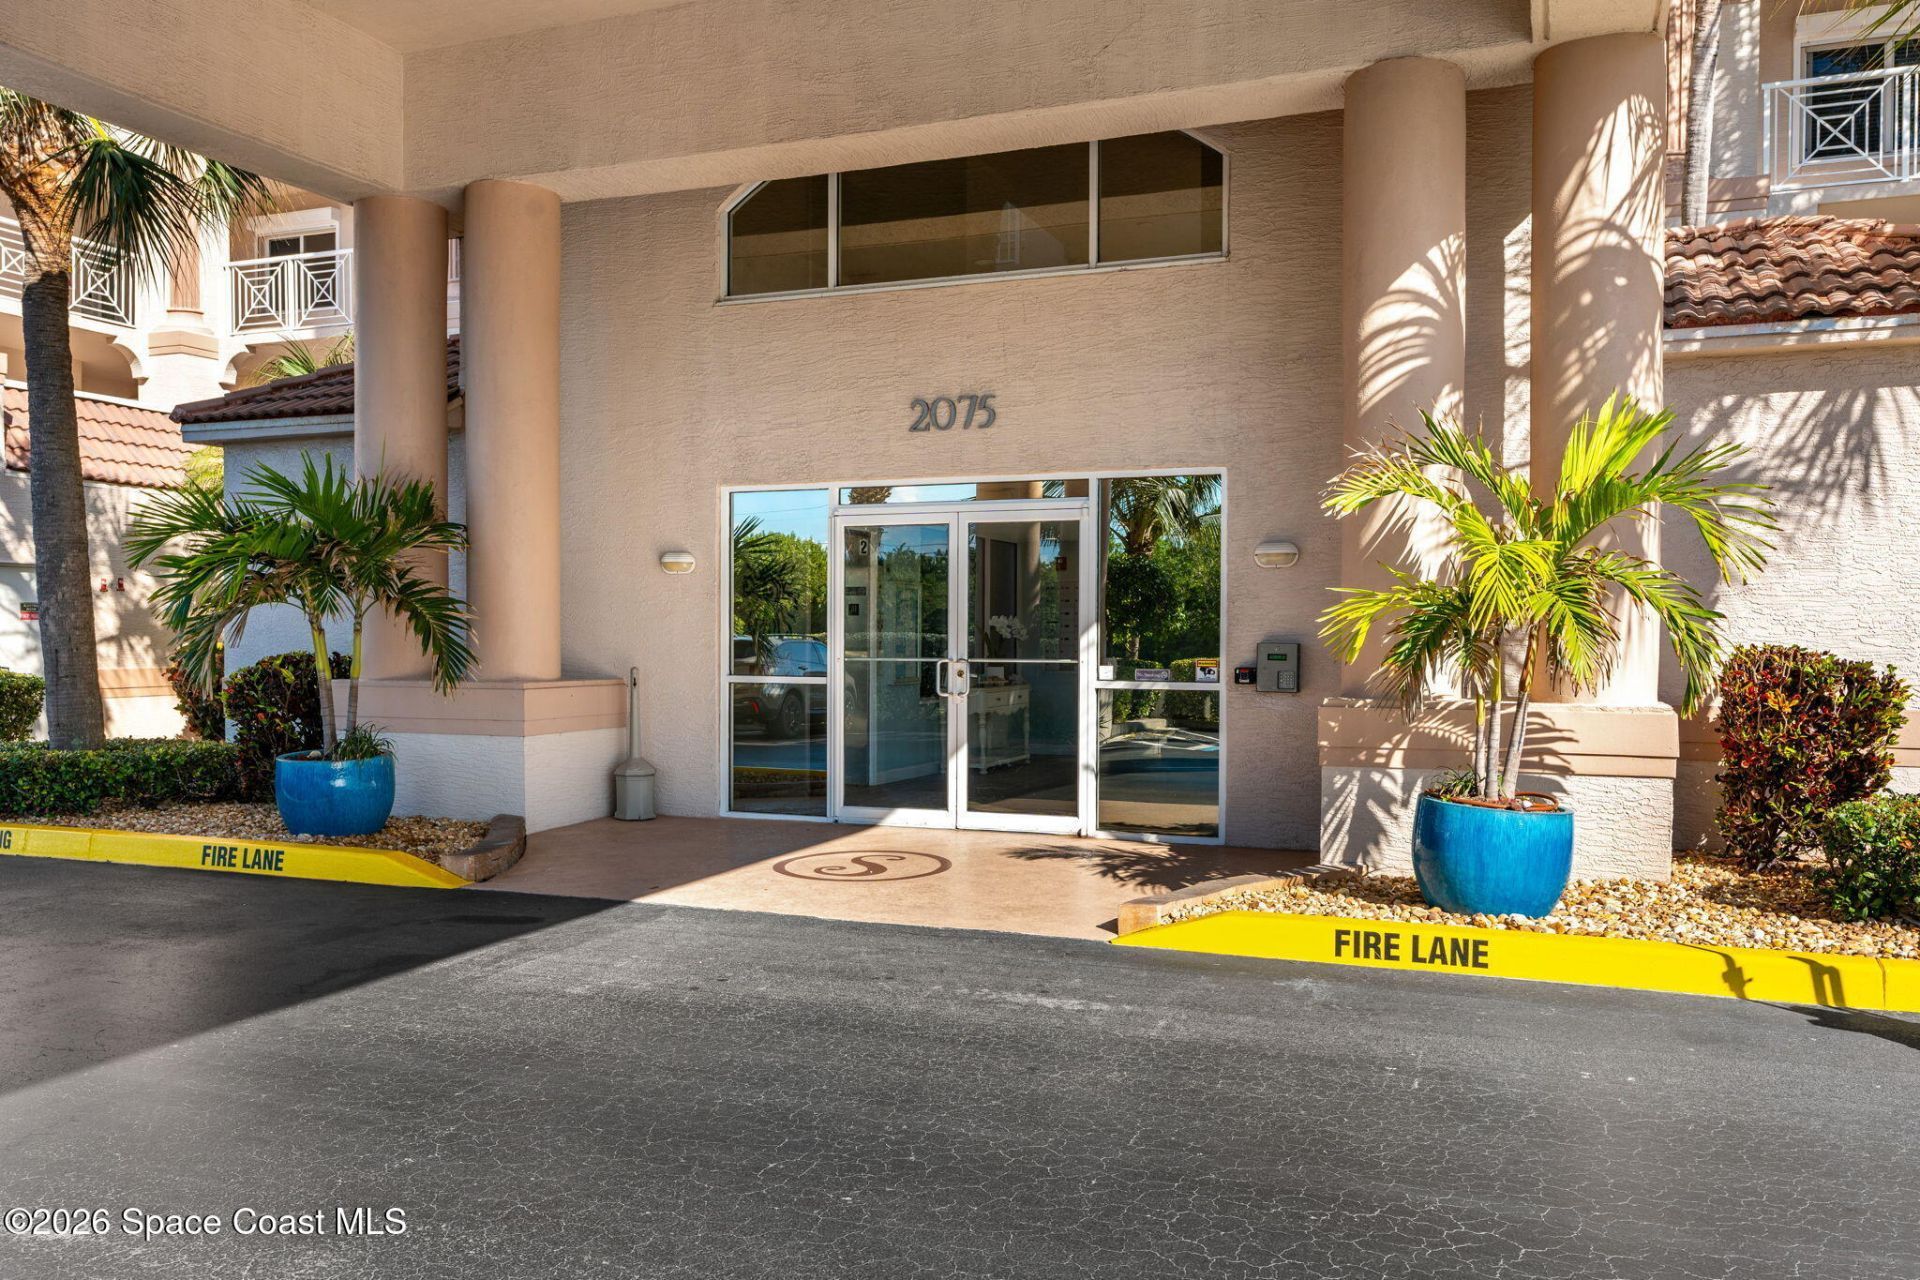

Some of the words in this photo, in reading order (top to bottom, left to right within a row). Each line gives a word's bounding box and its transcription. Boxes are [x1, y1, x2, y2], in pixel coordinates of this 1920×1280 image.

[908, 394, 996, 433] 2075
[201, 845, 237, 868] FIRE
[242, 848, 285, 871] LANE
[1335, 929, 1400, 961] FIRE
[1412, 935, 1489, 969] LANE
